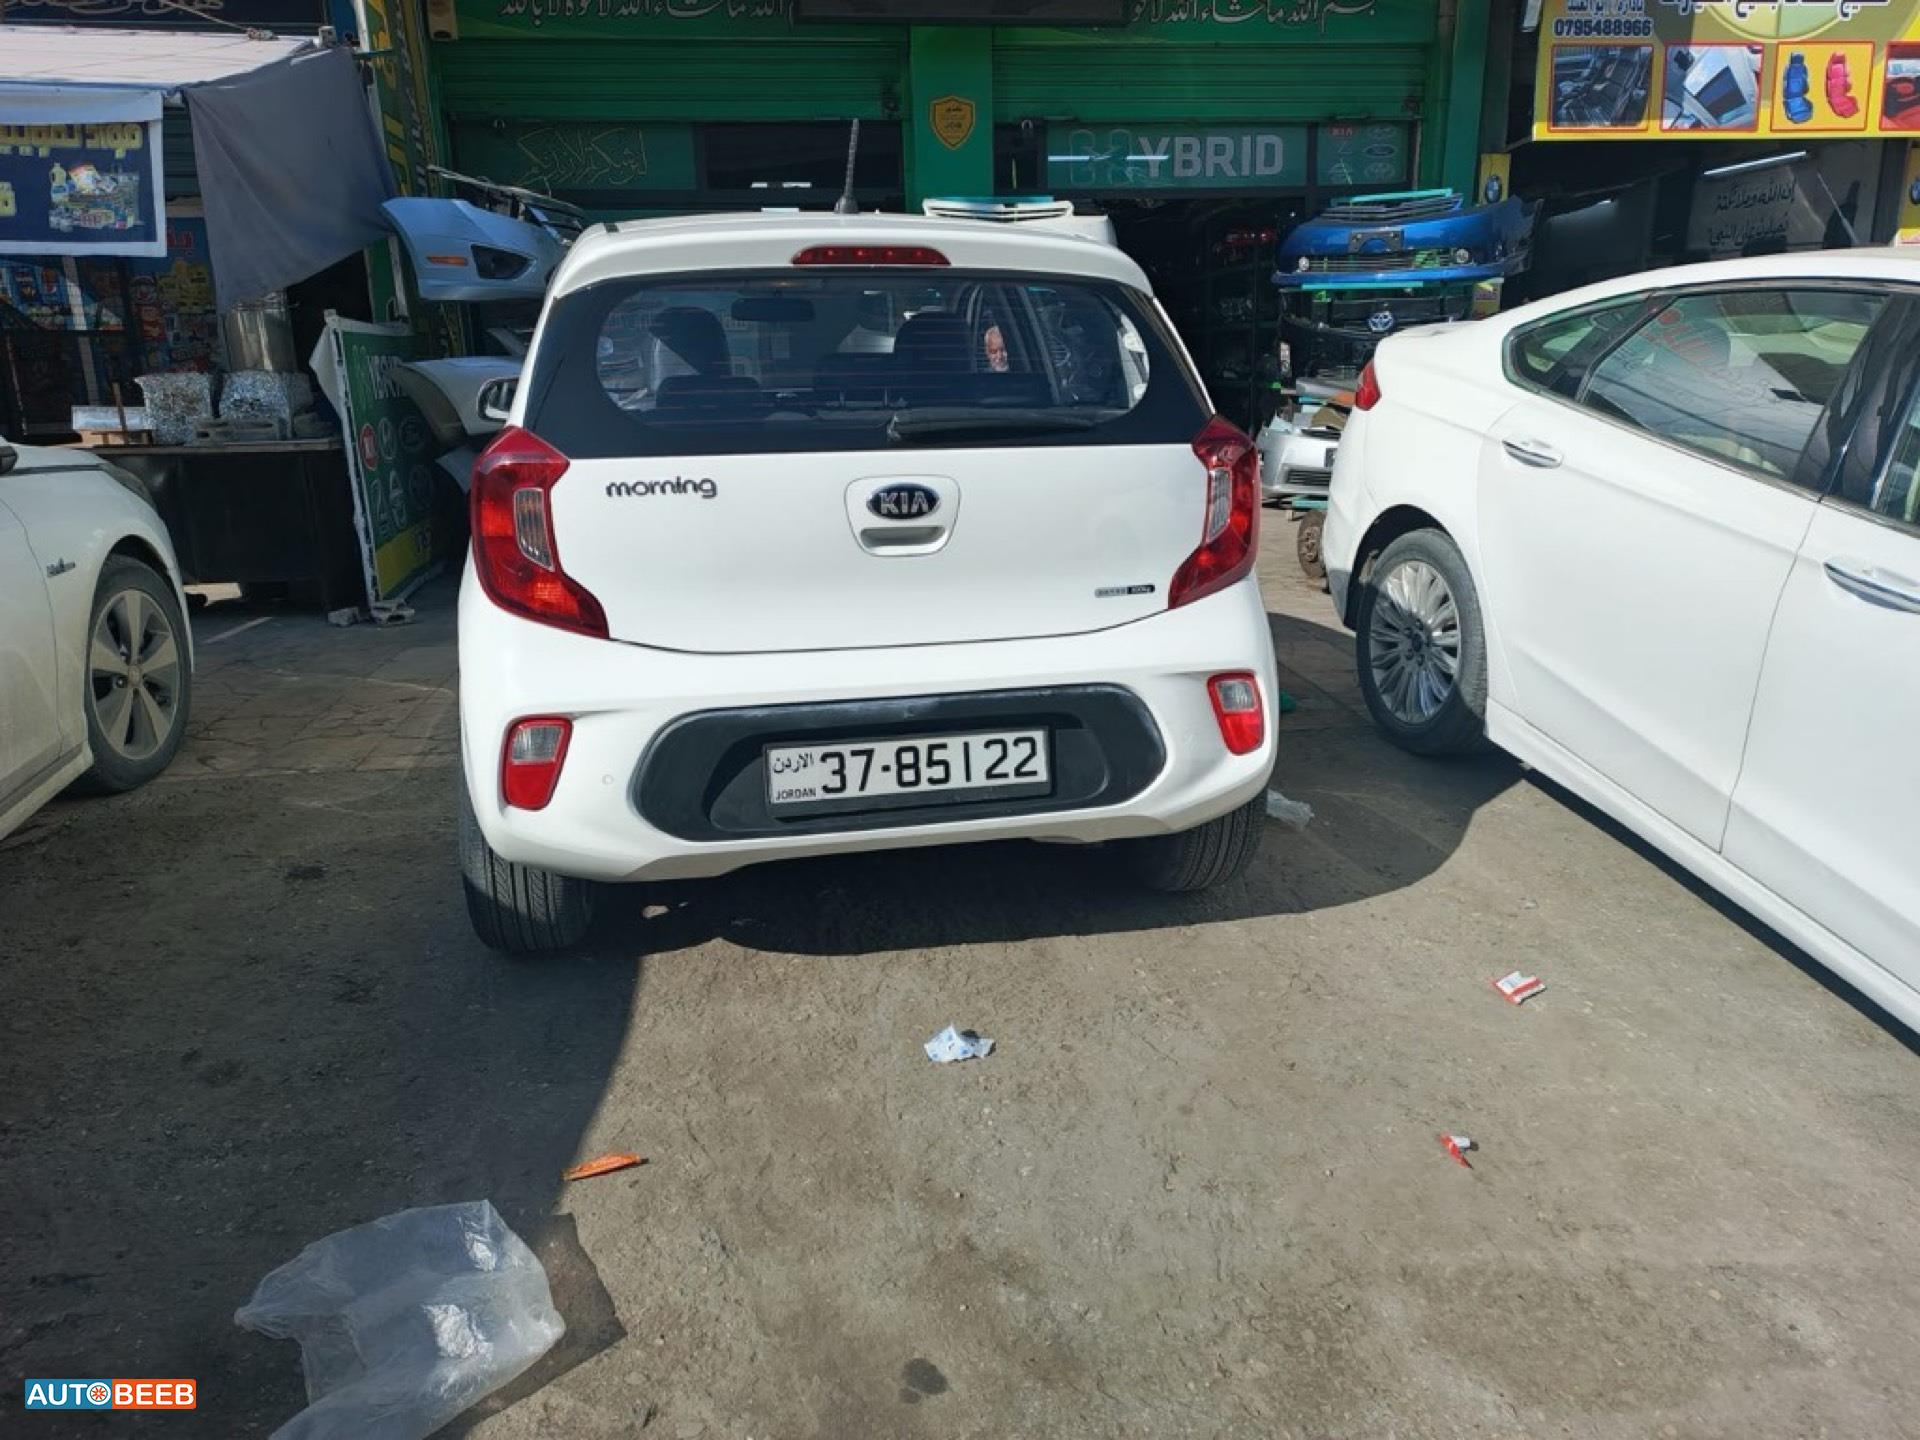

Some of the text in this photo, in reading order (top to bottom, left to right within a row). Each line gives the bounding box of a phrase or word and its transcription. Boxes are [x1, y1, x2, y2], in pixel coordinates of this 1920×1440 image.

[1553, 18, 1652, 37] 0795488966
[605, 475, 718, 499] morning
[879, 490, 929, 515] KIA
[820, 736, 1038, 794] 37-85122
[775, 787, 817, 801] JORDAN
